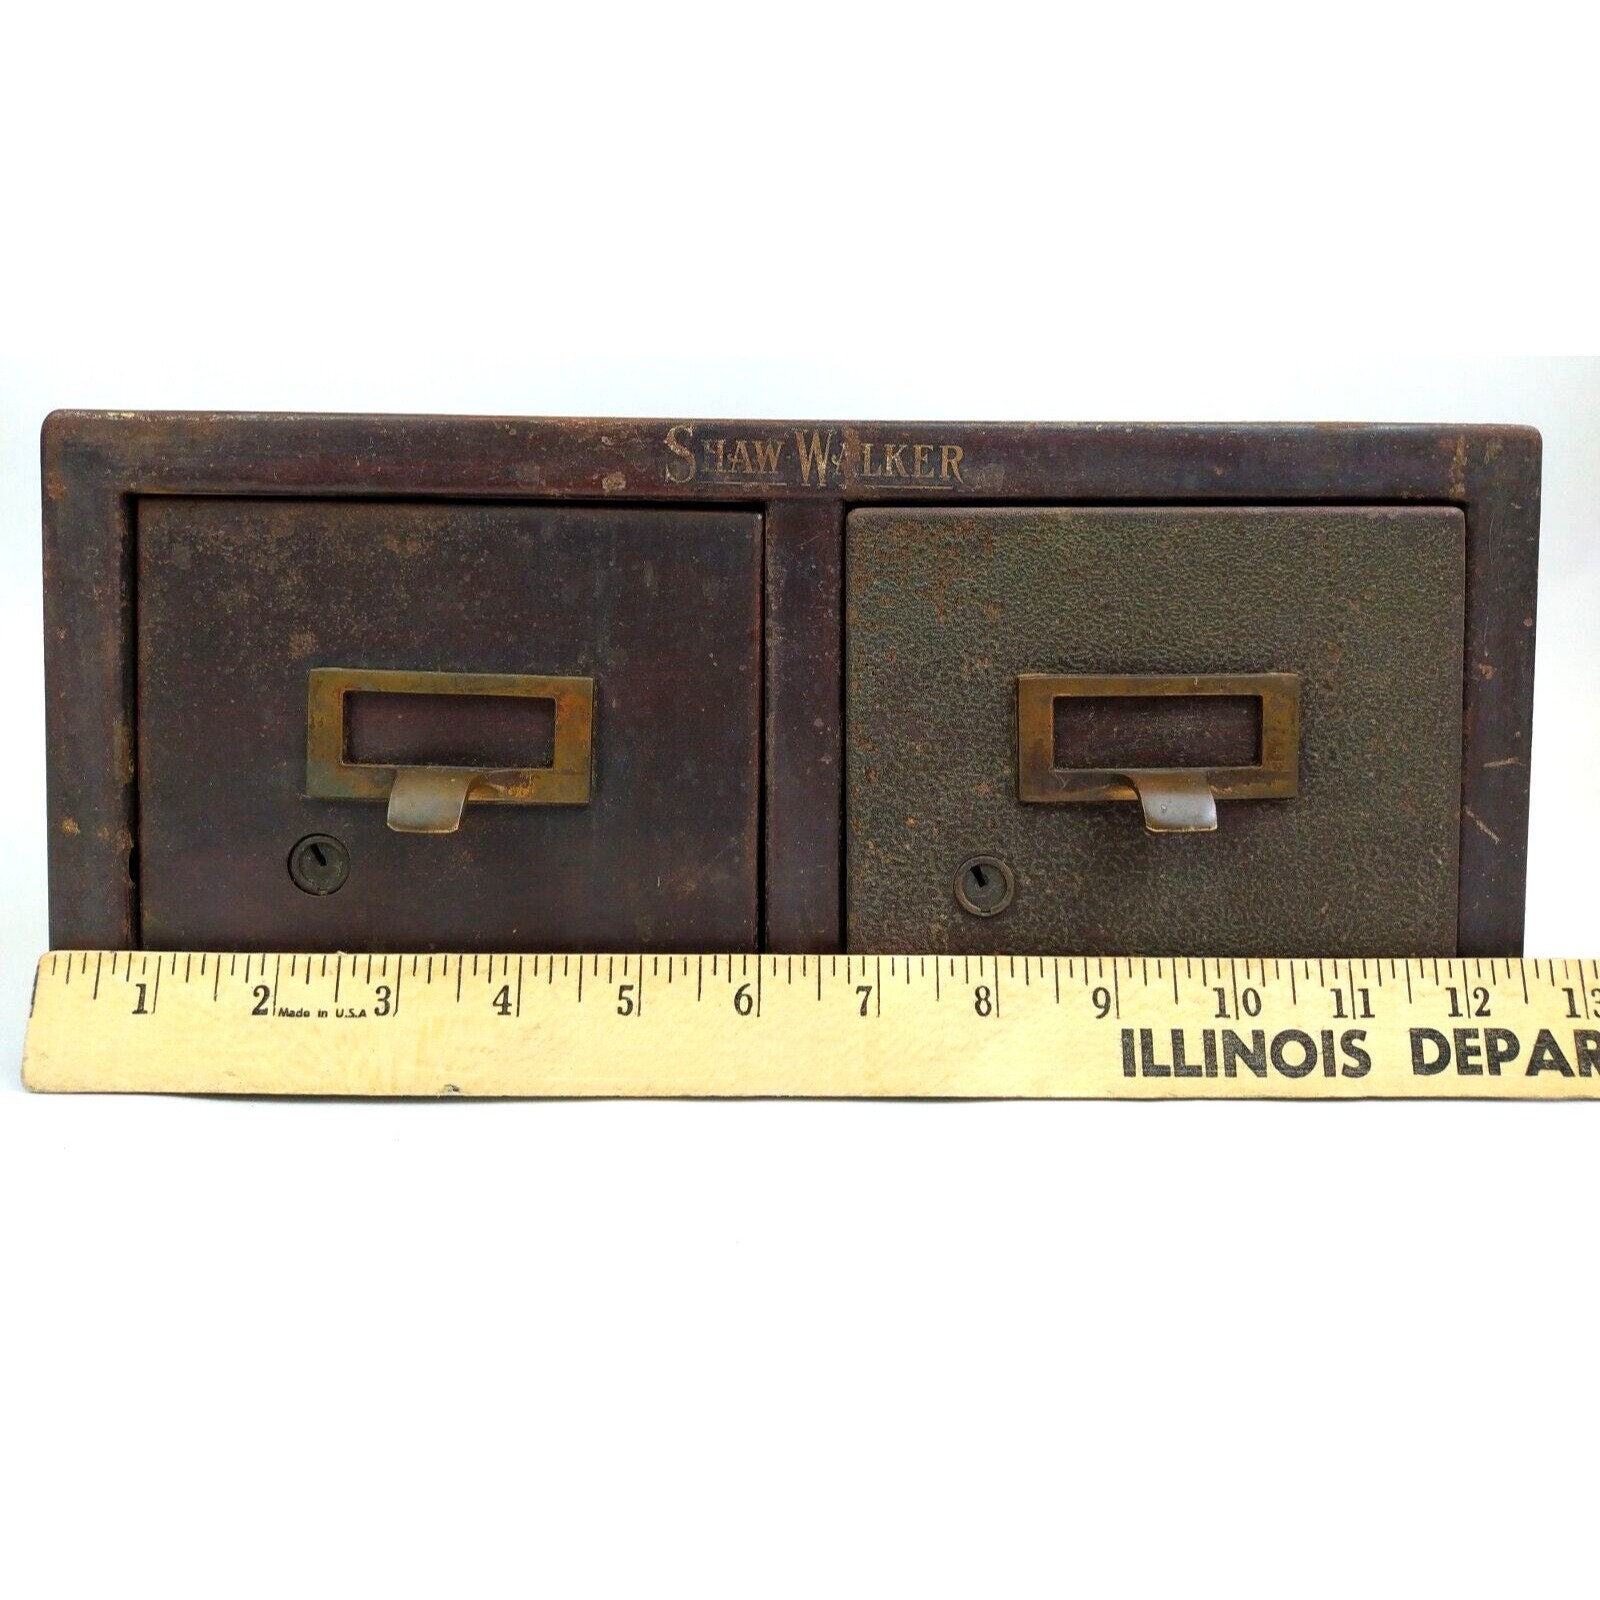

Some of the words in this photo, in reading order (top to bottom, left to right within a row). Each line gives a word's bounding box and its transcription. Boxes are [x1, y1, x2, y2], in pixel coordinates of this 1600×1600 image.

[132, 983, 148, 1015] 1
[252, 985, 271, 1016] 2
[374, 985, 392, 1016] 3
[492, 985, 513, 1017] 4
[617, 984, 635, 1017] 5
[734, 983, 753, 1017] 6
[855, 985, 873, 1017] 7
[974, 985, 992, 1017] 8
[1092, 986, 1111, 1019] 9
[278, 1007, 310, 1018] Made
[318, 1008, 328, 1018] in
[1121, 1027, 1372, 1079] ILLINOIS
[1409, 1027, 1600, 1078] DEPAR
